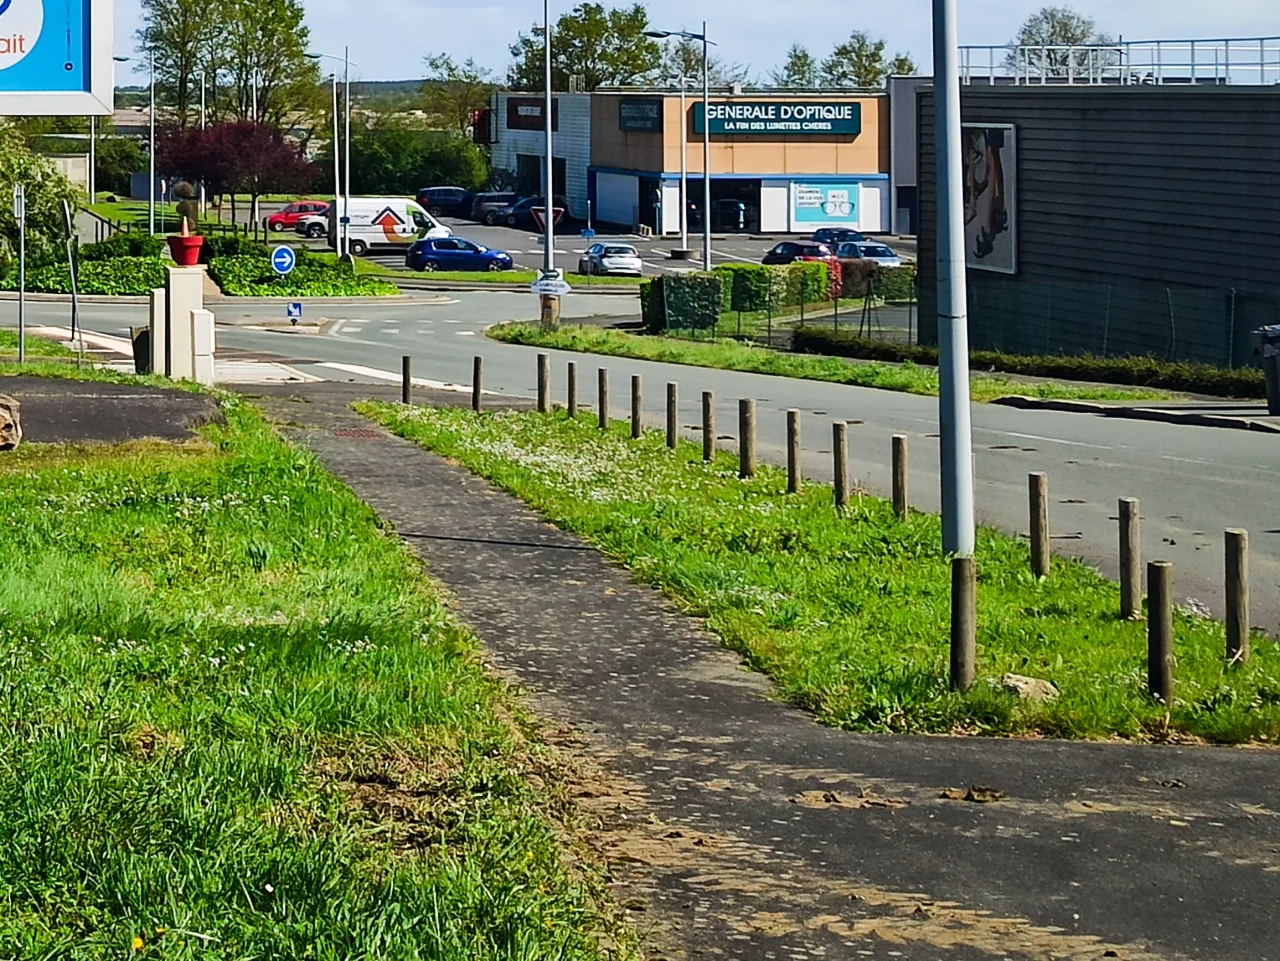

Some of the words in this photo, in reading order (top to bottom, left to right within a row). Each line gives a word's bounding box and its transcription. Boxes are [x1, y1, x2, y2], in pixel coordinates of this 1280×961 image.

[780, 105, 853, 119] D'OPTIQUE
[724, 121, 735, 130] LA
[736, 121, 749, 130] FIN
[750, 121, 765, 130] DES
